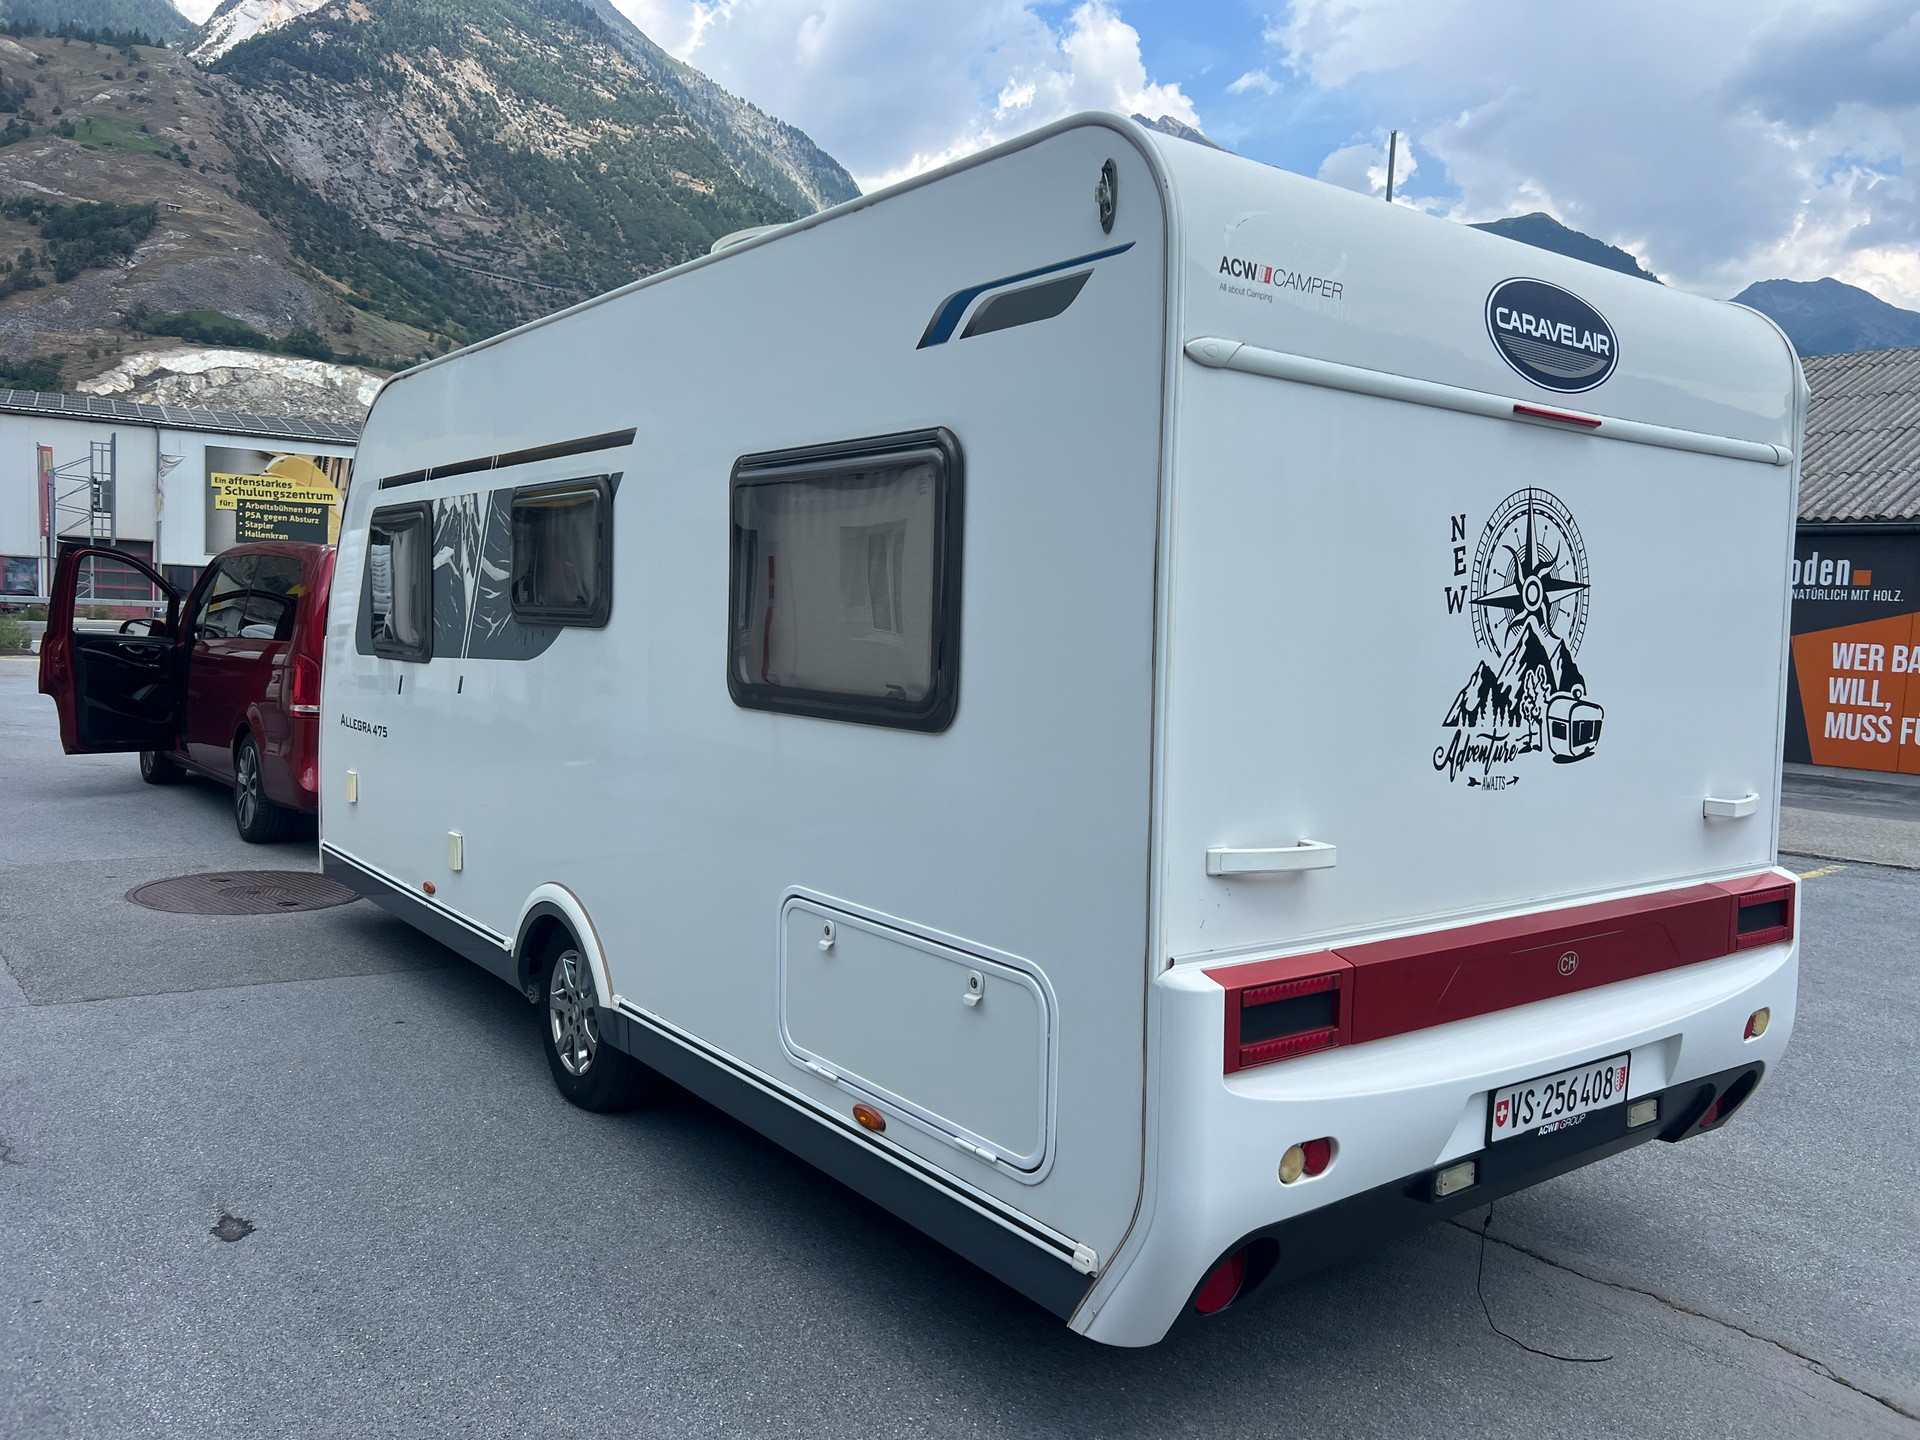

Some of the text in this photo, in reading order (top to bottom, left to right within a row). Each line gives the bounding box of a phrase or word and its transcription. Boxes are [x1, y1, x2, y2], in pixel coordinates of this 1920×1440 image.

[1219, 256, 1344, 300] ACW CAMPER
[1219, 283, 1273, 303] All about Camping
[1496, 306, 1610, 356] CARAVELAIR
[214, 476, 293, 489] Ein affenstarkes
[225, 486, 334, 501] Schulungszentrum
[219, 499, 234, 507] für:
[245, 502, 323, 515] Arbeitsbühnen IPAF
[245, 511, 320, 524] PSA gegen Absturz
[245, 521, 274, 530] Stapler
[245, 530, 289, 540] Hallenkran
[1850, 589, 1870, 601] MIT
[1873, 589, 1904, 602] HOLZ.
[1832, 642, 1885, 672] WER
[1828, 676, 1892, 712] WILL,
[340, 713, 388, 738] ALLEGRA 475
[1824, 711, 1893, 744] MUSS
[1433, 728, 1519, 783] Adventure
[1481, 775, 1506, 791] AWAITS
[1560, 955, 1576, 972] CH
[1538, 1113, 1587, 1136] ACW GROUP
